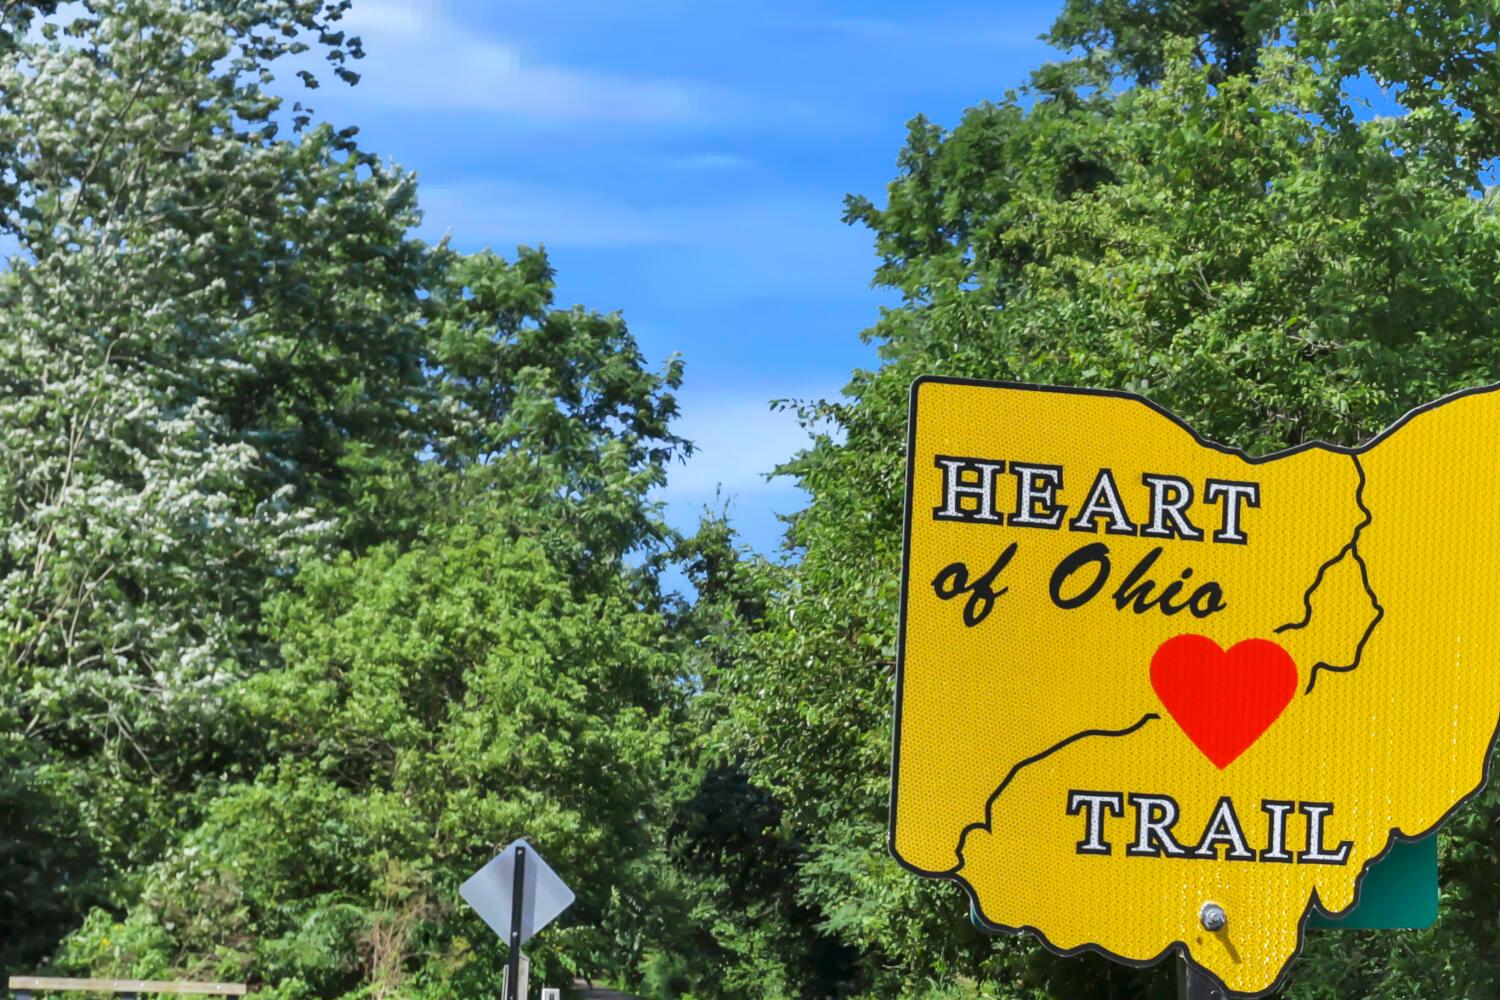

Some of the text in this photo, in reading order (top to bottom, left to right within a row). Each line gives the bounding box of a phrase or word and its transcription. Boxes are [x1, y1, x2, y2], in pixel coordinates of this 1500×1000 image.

[933, 455, 1260, 544] HEART
[931, 542, 1227, 628] of Ohio
[1066, 789, 1354, 866] TRAIL
